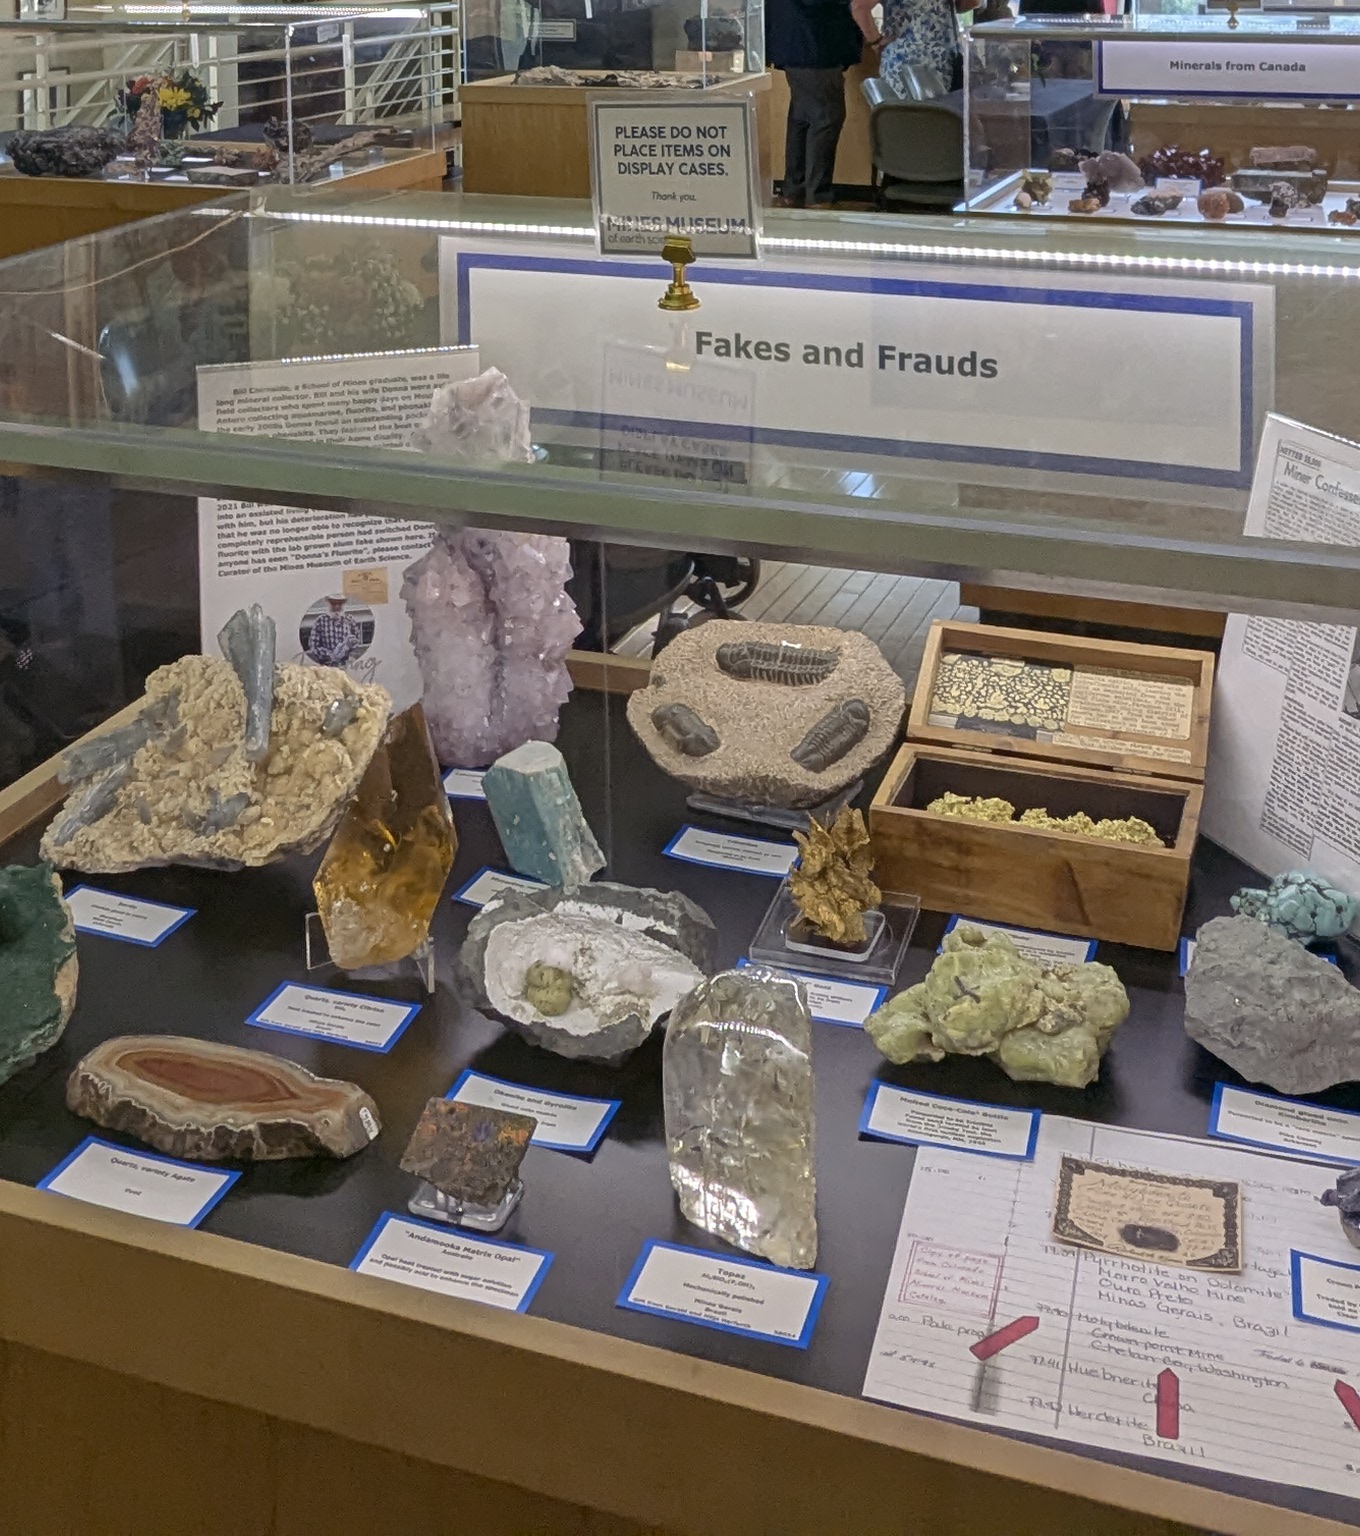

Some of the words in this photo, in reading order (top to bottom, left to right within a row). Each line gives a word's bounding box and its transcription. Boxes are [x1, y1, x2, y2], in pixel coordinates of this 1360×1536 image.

[1170, 61, 1222, 71] Minerals
[1226, 62, 1255, 71] from
[1259, 62, 1306, 72] Canada
[616, 126, 666, 139] PLEASE
[671, 126, 691, 139] DO
[697, 126, 727, 139] NOT
[614, 145, 657, 156] PLACE
[662, 145, 704, 157] ITEMS
[708, 145, 731, 157] ON
[618, 163, 674, 175] DISPLAY
[679, 163, 728, 176] CASES.
[652, 191, 676, 200] Thank
[680, 194, 696, 202] you.
[607, 216, 662, 232] MINES
[666, 216, 746, 235] MUSEUM
[608, 234, 618, 242] of
[620, 235, 645, 243] earth
[695, 331, 790, 361] Fakes
[803, 343, 864, 368] and
[878, 344, 998, 378] Frauds
[1284, 462, 1312, 484] Miner
[249, 509, 283, 517] assisted
[291, 513, 345, 523] deterioration
[283, 526, 309, 534] longer
[343, 520, 382, 528] recognize
[218, 539, 263, 548] completely
[266, 534, 324, 544] reprehensible
[327, 532, 355, 540] person
[375, 525, 411, 534] switched
[304, 542, 331, 551] grown
[373, 545, 398, 553] please
[401, 542, 431, 550] contact
[218, 569, 250, 577] Curator
[307, 560, 341, 569] Museum
[354, 556, 376, 564] Earth
[379, 554, 412, 562] Science.
[527, 1096, 543, 1104] and
[111, 1157, 138, 1169] Quartz,
[141, 1166, 170, 1177] variety
[172, 1173, 195, 1182] Agate
[405, 1230, 461, 1250] "Andamooka
[463, 1247, 492, 1258] Matrix
[494, 1253, 521, 1262] Opal"
[718, 1268, 745, 1279] Topaz
[1084, 1251, 1169, 1277] Pyrrhotite
[1179, 1273, 1197, 1283] on
[1207, 1277, 1282, 1299] Dolomite
[1099, 1267, 1147, 1284] Morro
[1207, 1289, 1245, 1303] Mine
[1099, 1278, 1140, 1295] Ouro
[1149, 1288, 1193, 1305] Preto
[1098, 1291, 1146, 1308] Minas
[1233, 1316, 1289, 1337] Brazil
[1198, 1365, 1289, 1388] Washington
[1142, 1433, 1205, 1458] Brazil
